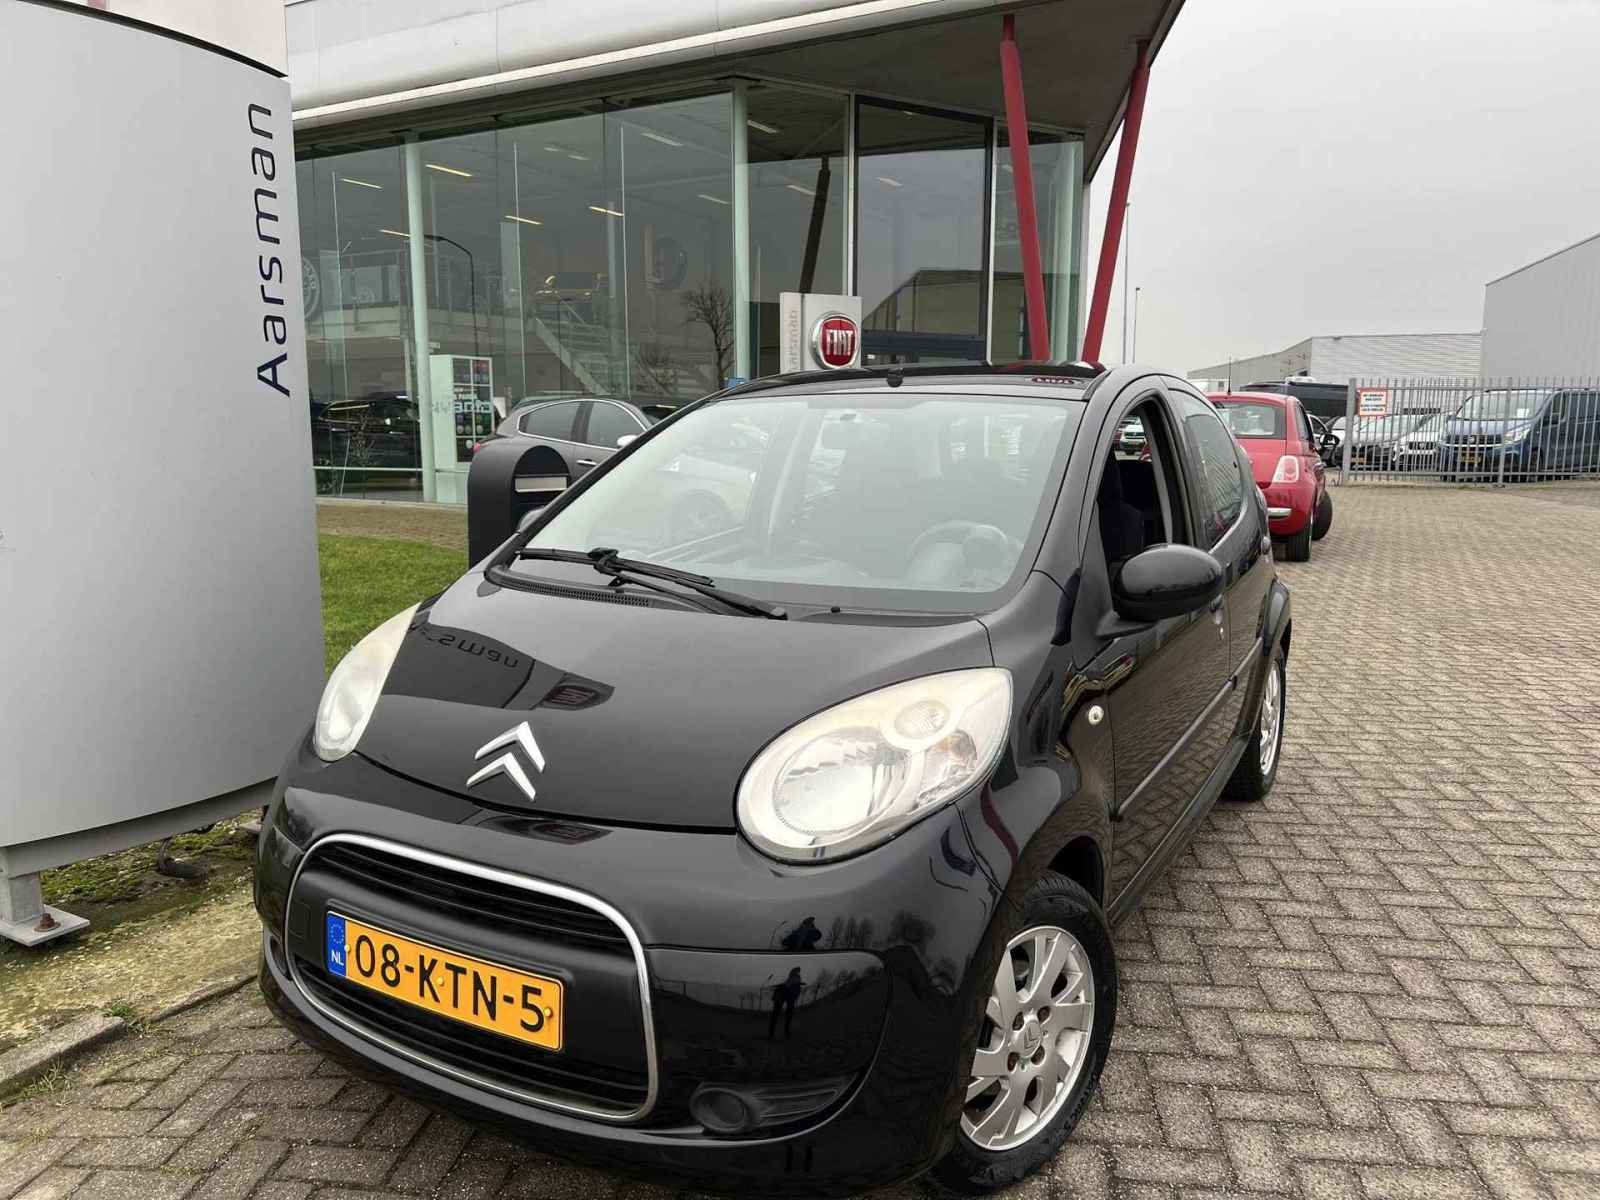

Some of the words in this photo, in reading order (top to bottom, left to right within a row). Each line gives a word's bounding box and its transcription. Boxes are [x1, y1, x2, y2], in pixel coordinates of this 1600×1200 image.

[247, 103, 290, 397] Aarsman
[825, 329, 854, 356] FIAT
[330, 949, 345, 967] NL
[355, 934, 546, 1032] 08-KTN-5
